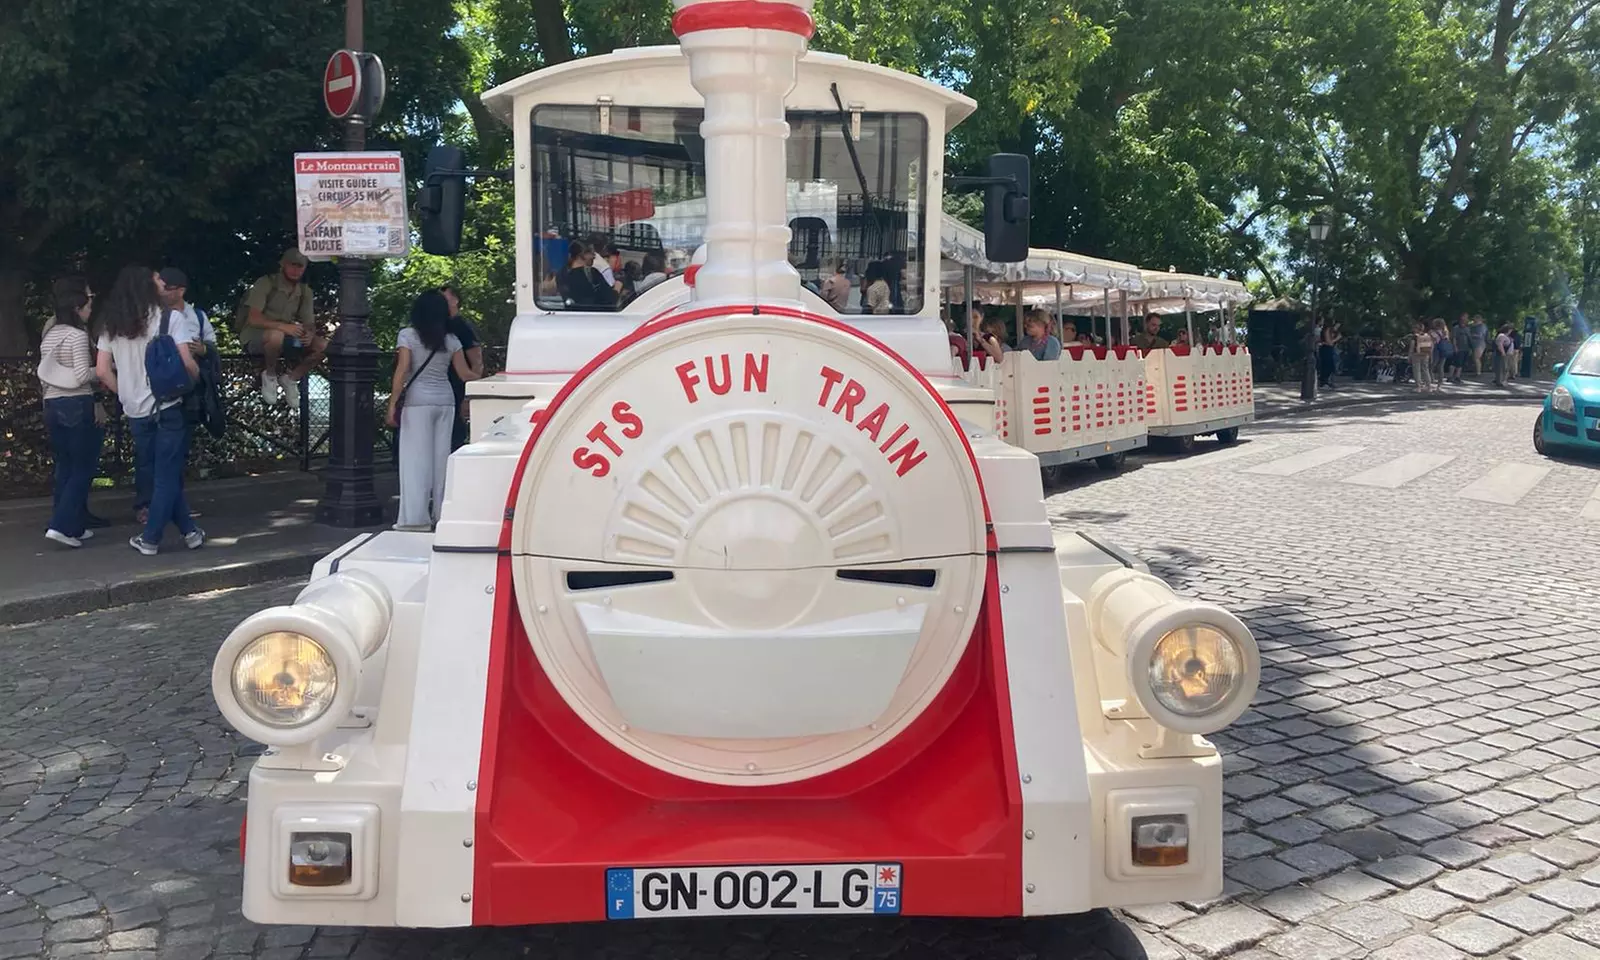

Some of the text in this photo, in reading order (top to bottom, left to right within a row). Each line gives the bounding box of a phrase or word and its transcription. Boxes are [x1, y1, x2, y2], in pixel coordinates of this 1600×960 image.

[300, 160, 396, 171] Le Montmartrain
[318, 179, 344, 188] VISITE
[353, 191, 365, 201] 35
[303, 225, 343, 238] ENFANT
[304, 239, 342, 251] ADULTE
[572, 353, 928, 478] STS FUN TRAIN
[615, 869, 897, 911] F GN-002-LG 75
